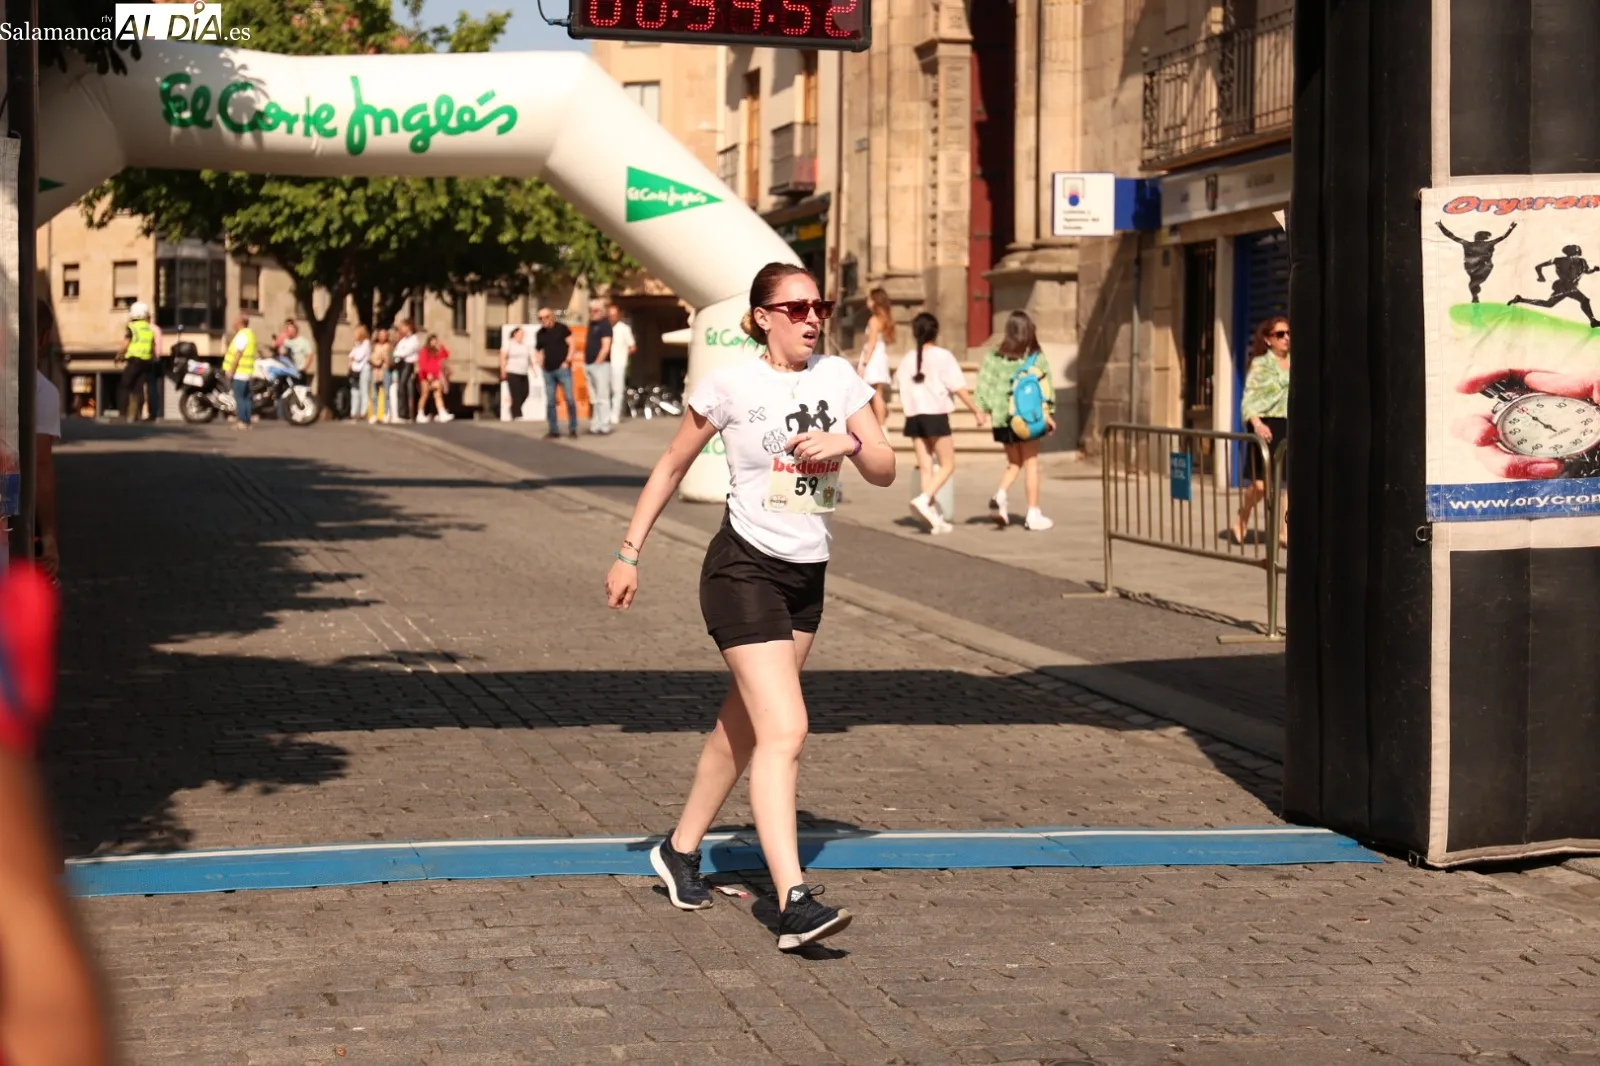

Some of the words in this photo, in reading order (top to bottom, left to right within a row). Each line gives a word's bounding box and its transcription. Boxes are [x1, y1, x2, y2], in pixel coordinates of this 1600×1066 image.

[160, 72, 213, 129] El
[218, 81, 338, 139] Corte
[346, 75, 518, 157] Inglés
[795, 476, 819, 496] 59
